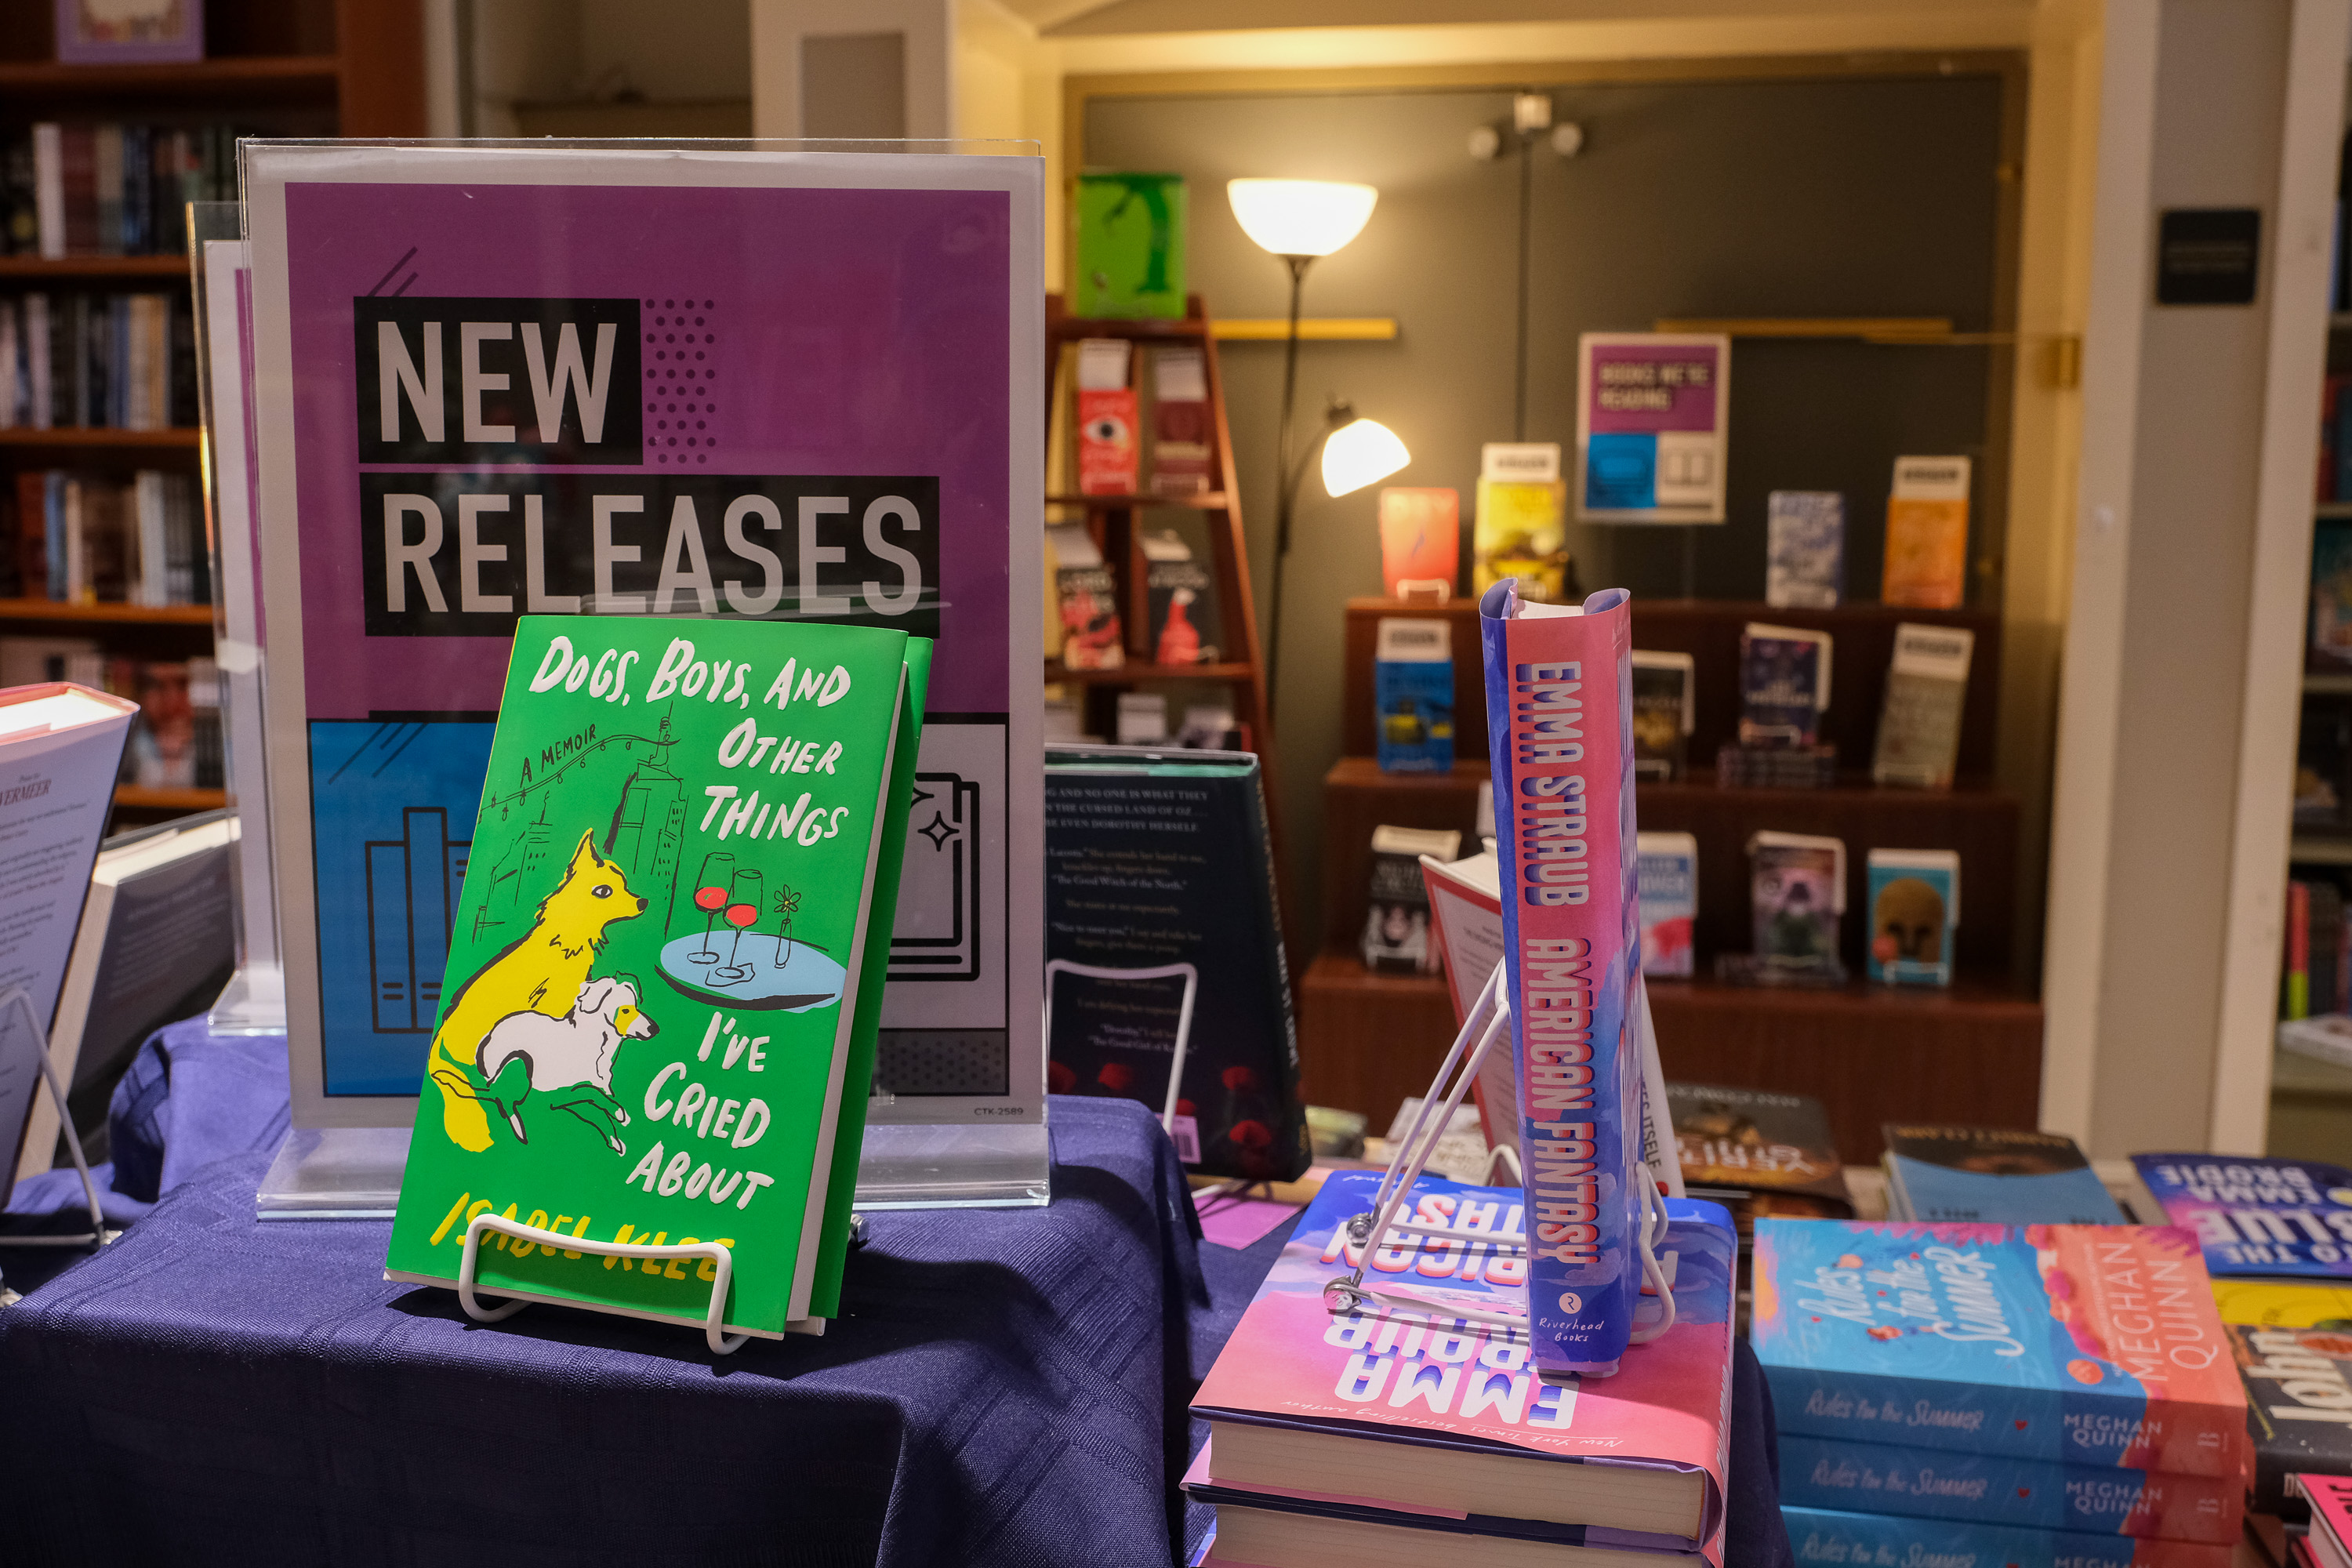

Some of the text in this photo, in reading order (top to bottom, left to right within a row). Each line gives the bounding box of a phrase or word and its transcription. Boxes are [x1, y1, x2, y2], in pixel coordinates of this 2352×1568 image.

[378, 321, 617, 444] NEW
[383, 493, 922, 616] RELEASES
[764, 658, 851, 710] AND
[521, 724, 597, 787] A MEMOIR
[718, 718, 843, 775] OTHER
[700, 786, 849, 847] THINGS
[1526, 661, 1591, 1264] EMMA STRAUB AMERICAN FANTASY
[644, 1062, 771, 1150] CRIED
[975, 1107, 1024, 1116] CTK-2589
[1642, 1116, 1662, 1169] ITSELF
[626, 1140, 775, 1210] ABOUT
[1538, 1317, 1605, 1331] Riverhead
[1555, 1331, 1589, 1342] Books
[2097, 1242, 2169, 1381] MEGHAN
[2145, 1260, 2220, 1370] QUINN
[1334, 1354, 1581, 1430] EMMA
[1348, 1407, 1457, 1429] bestselling
[1471, 1426, 1523, 1441] Times
[1532, 1434, 1573, 1446] York
[1577, 1438, 1624, 1448] New
[2063, 1413, 2163, 1436] MEGHAN
[2072, 1428, 2151, 1449] QUINN
[2065, 1480, 2163, 1501] MEGHAN
[2074, 1495, 2151, 1515] QUINN
